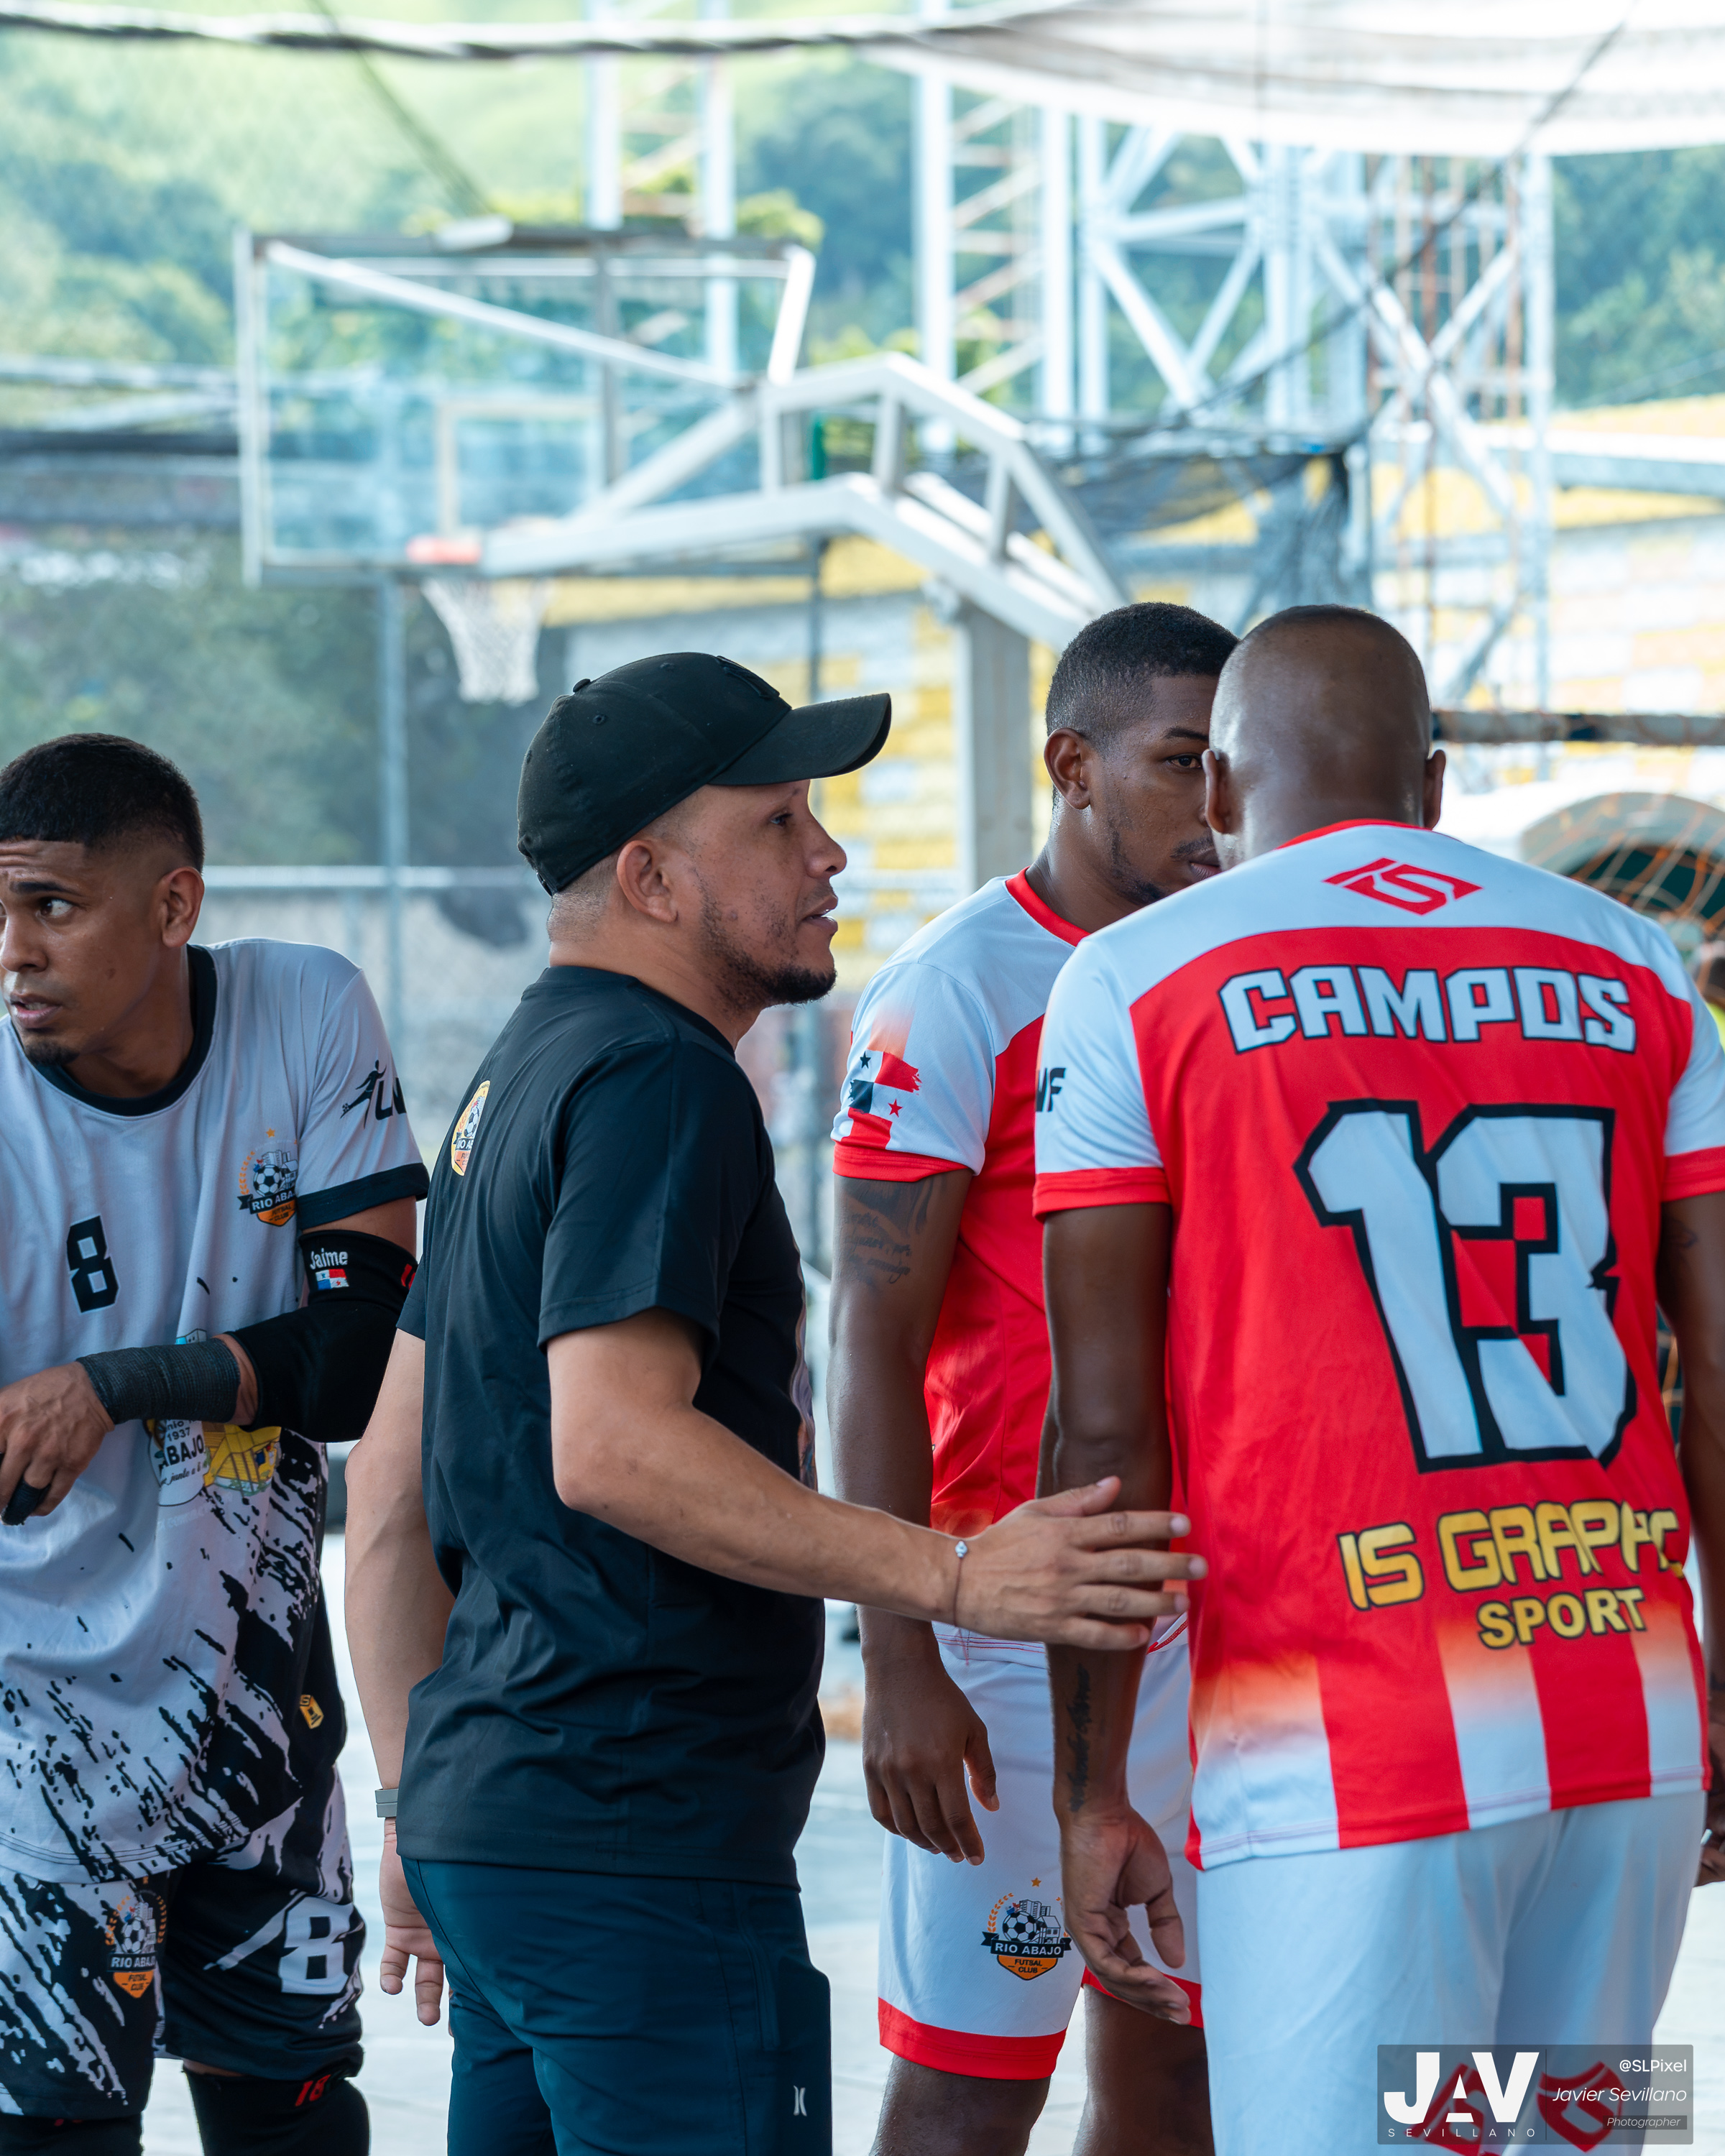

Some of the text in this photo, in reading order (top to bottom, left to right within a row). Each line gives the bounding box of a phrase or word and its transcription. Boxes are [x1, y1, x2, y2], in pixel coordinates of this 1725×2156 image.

[1220, 964, 1637, 1054] CAMPOS
[252, 1198, 273, 1211] RIO
[66, 1214, 119, 1314] 8
[310, 1248, 349, 1270] Jaime
[1292, 1097, 1638, 1475] 13
[167, 1427, 190, 1442] 1937
[1337, 1522, 1425, 1611] IS
[1476, 1587, 1646, 1649] SPORT
[111, 1957, 132, 1968] RIO
[277, 1896, 353, 1995] 8
[995, 1943, 1062, 1955] RIO ABAJO
